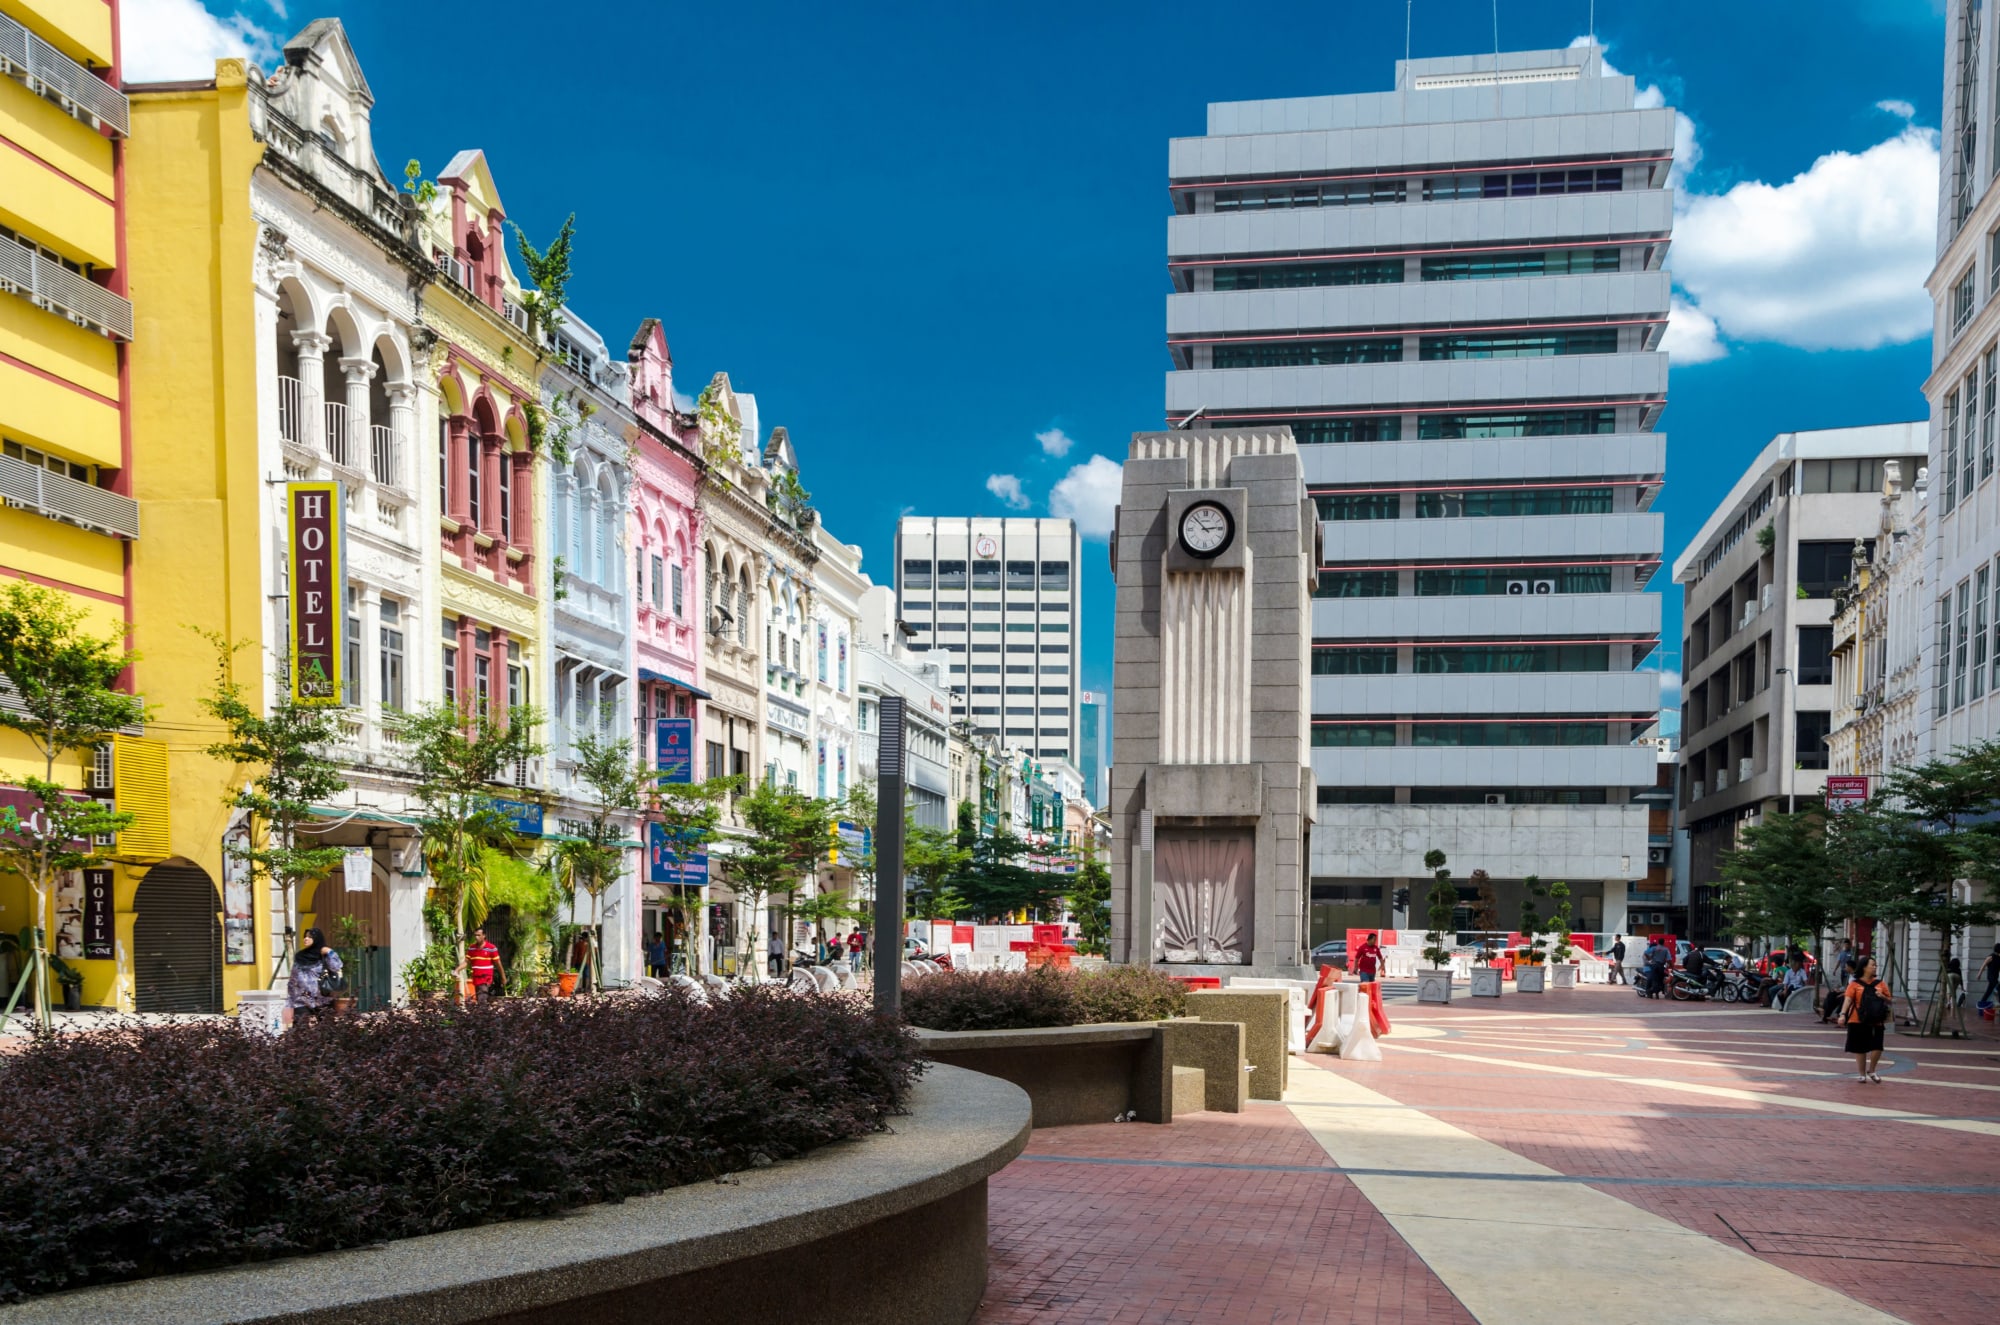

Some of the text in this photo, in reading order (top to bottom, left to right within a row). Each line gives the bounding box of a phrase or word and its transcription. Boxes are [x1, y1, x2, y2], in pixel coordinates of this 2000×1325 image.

[301, 495, 325, 646] HOTEL
[301, 681, 333, 695] ONE
[305, 658, 327, 681] A
[93, 873, 105, 940] HOTEL
